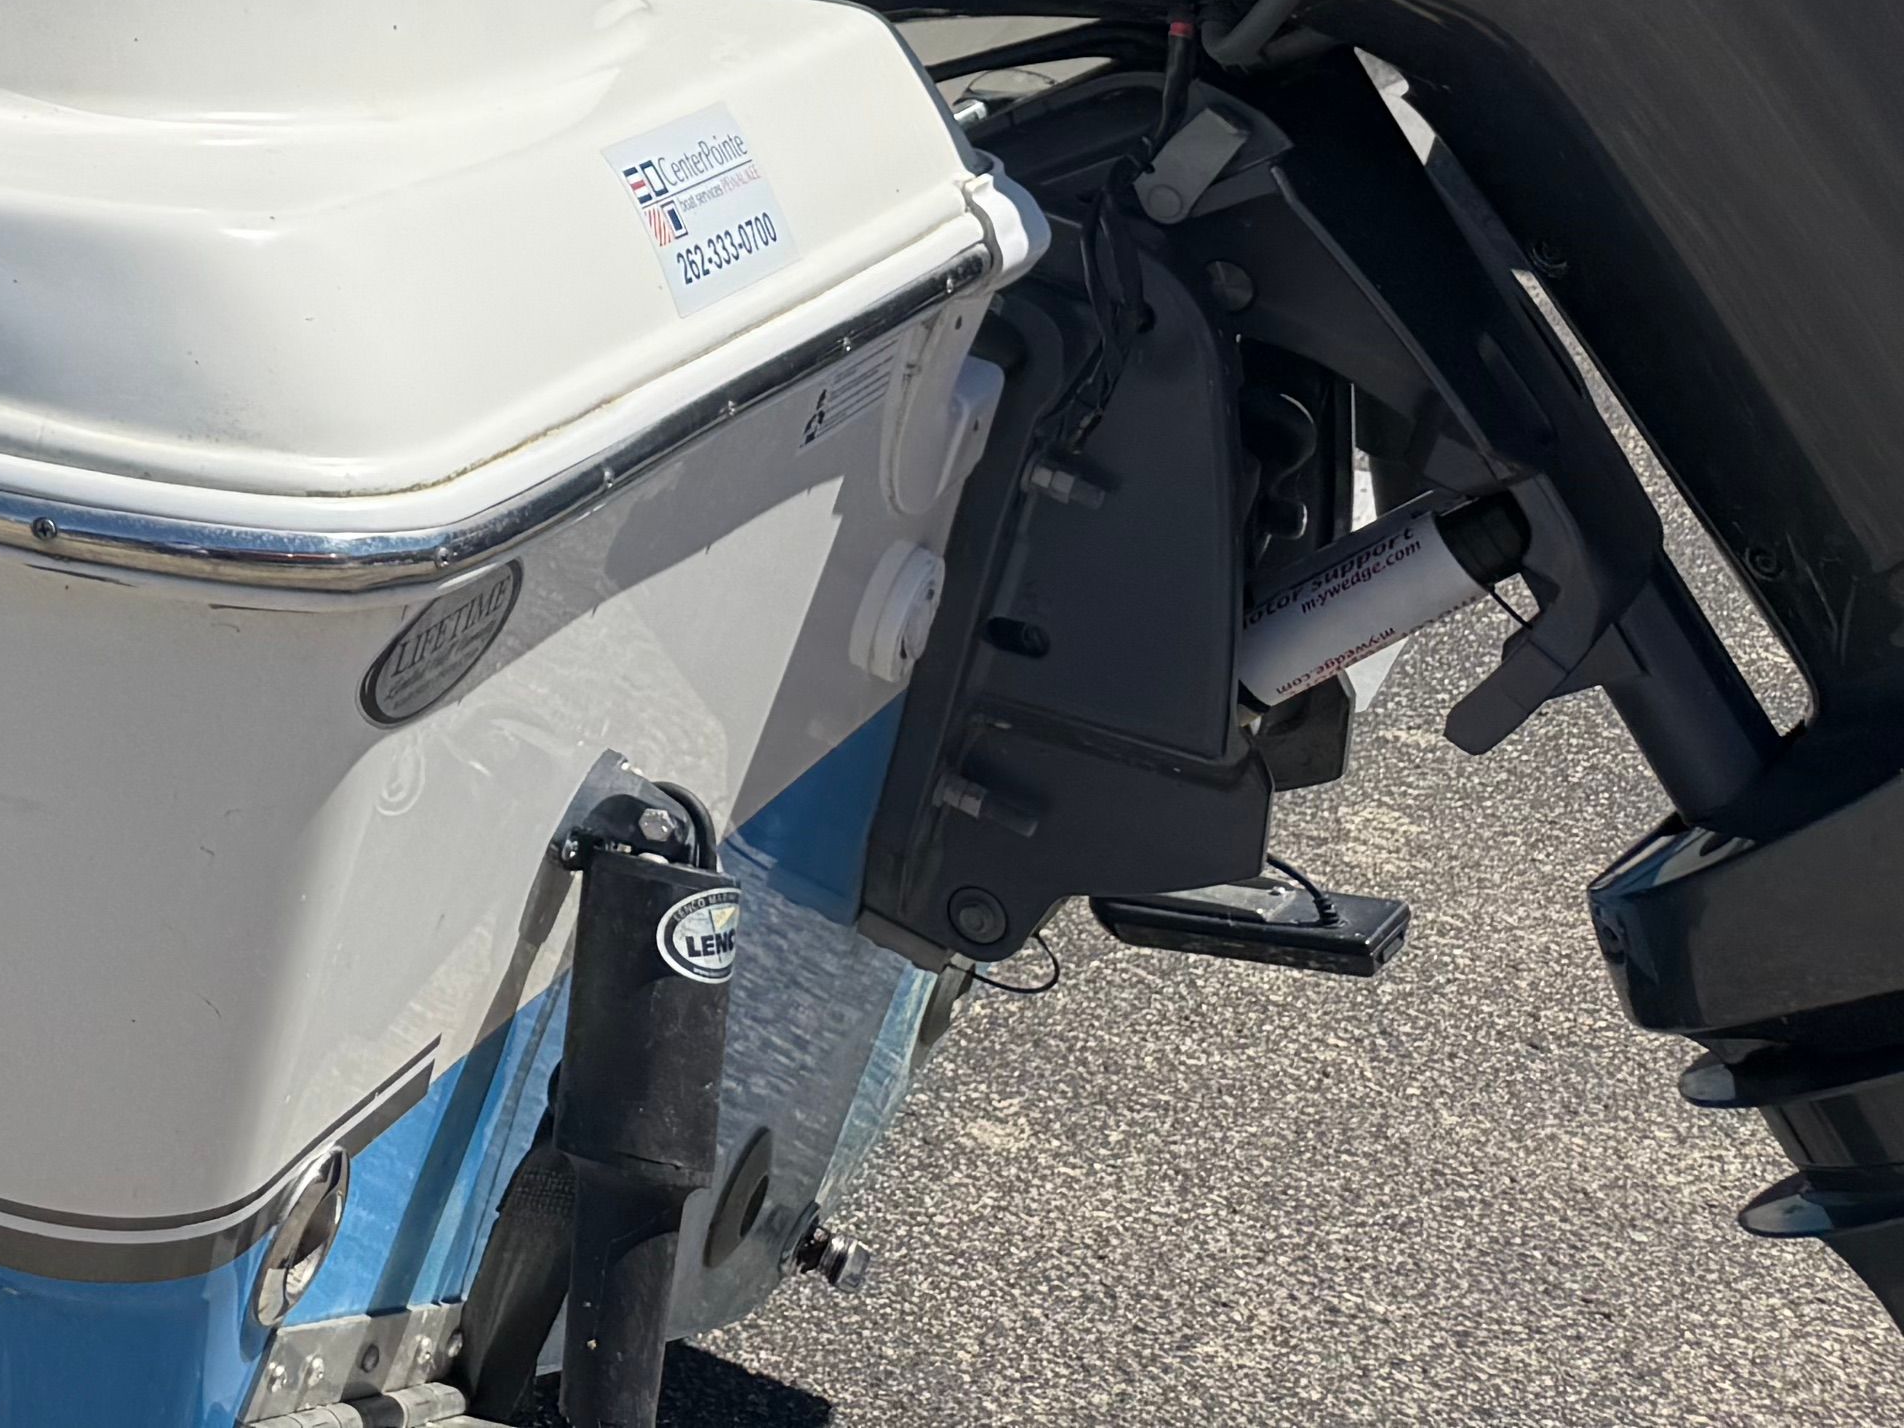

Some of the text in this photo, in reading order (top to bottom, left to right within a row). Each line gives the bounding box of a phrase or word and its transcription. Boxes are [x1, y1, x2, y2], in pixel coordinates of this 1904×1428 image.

[657, 133, 748, 187] CenterPointe
[676, 211, 778, 285] 262-333-0700
[1311, 526, 1415, 592] support
[390, 574, 512, 679] LIFETIME
[673, 897, 706, 922] LENCO
